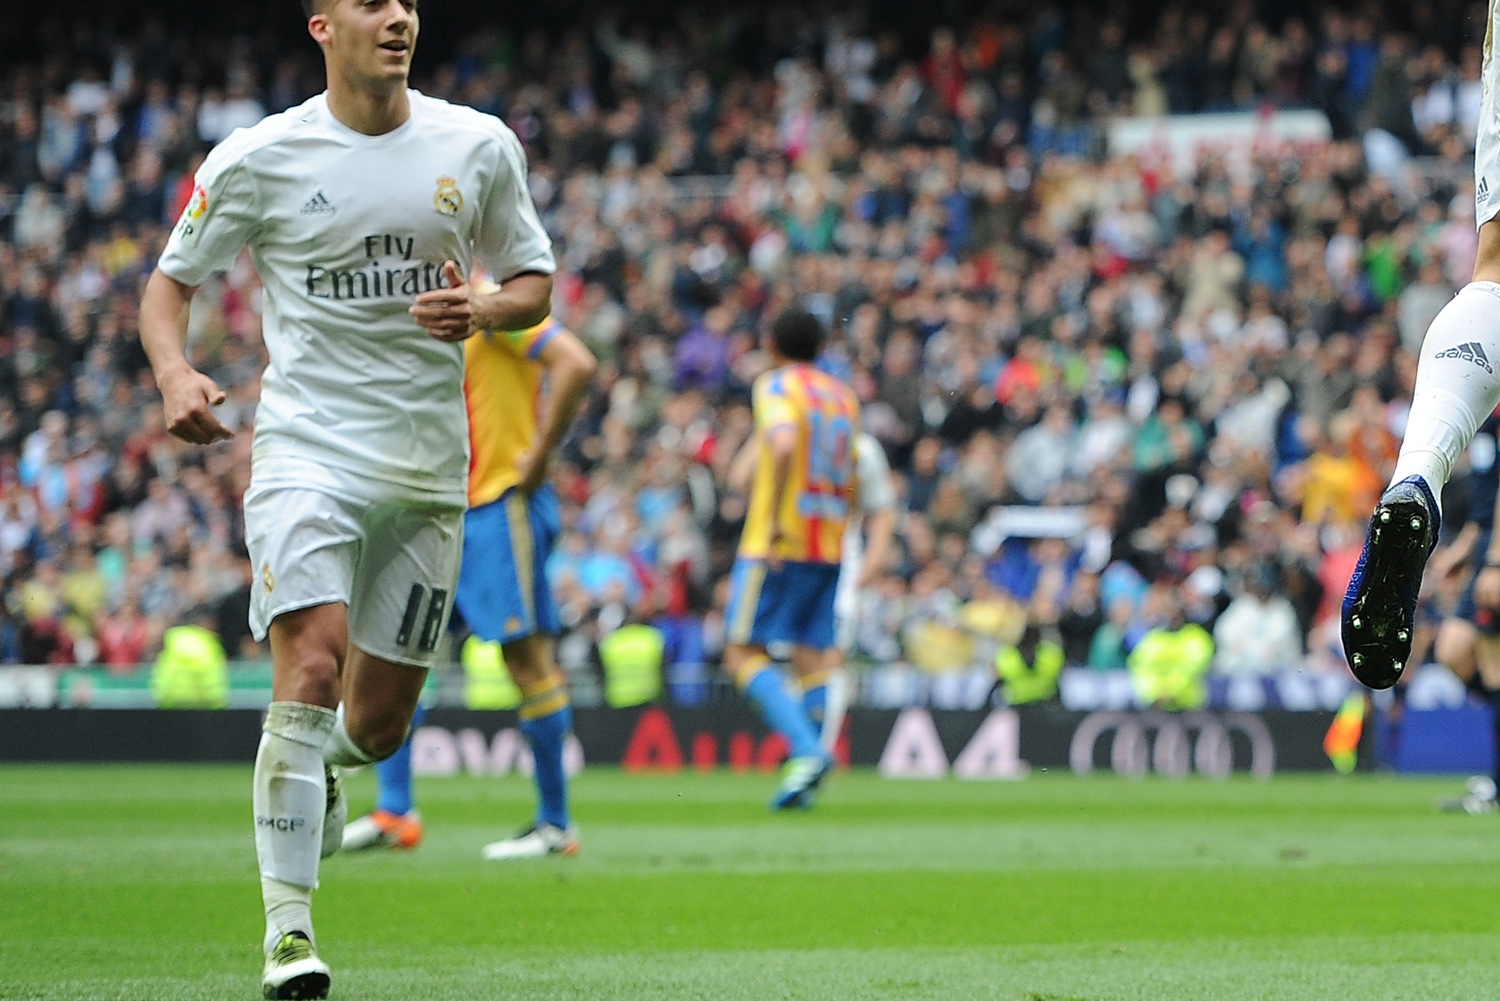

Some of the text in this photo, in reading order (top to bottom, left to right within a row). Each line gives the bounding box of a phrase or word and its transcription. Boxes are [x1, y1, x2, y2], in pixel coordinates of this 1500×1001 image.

[365, 234, 414, 261] Fly
[306, 261, 461, 299] Emirate
[1435, 347, 1493, 374] adidas
[877, 706, 1031, 778] A4
